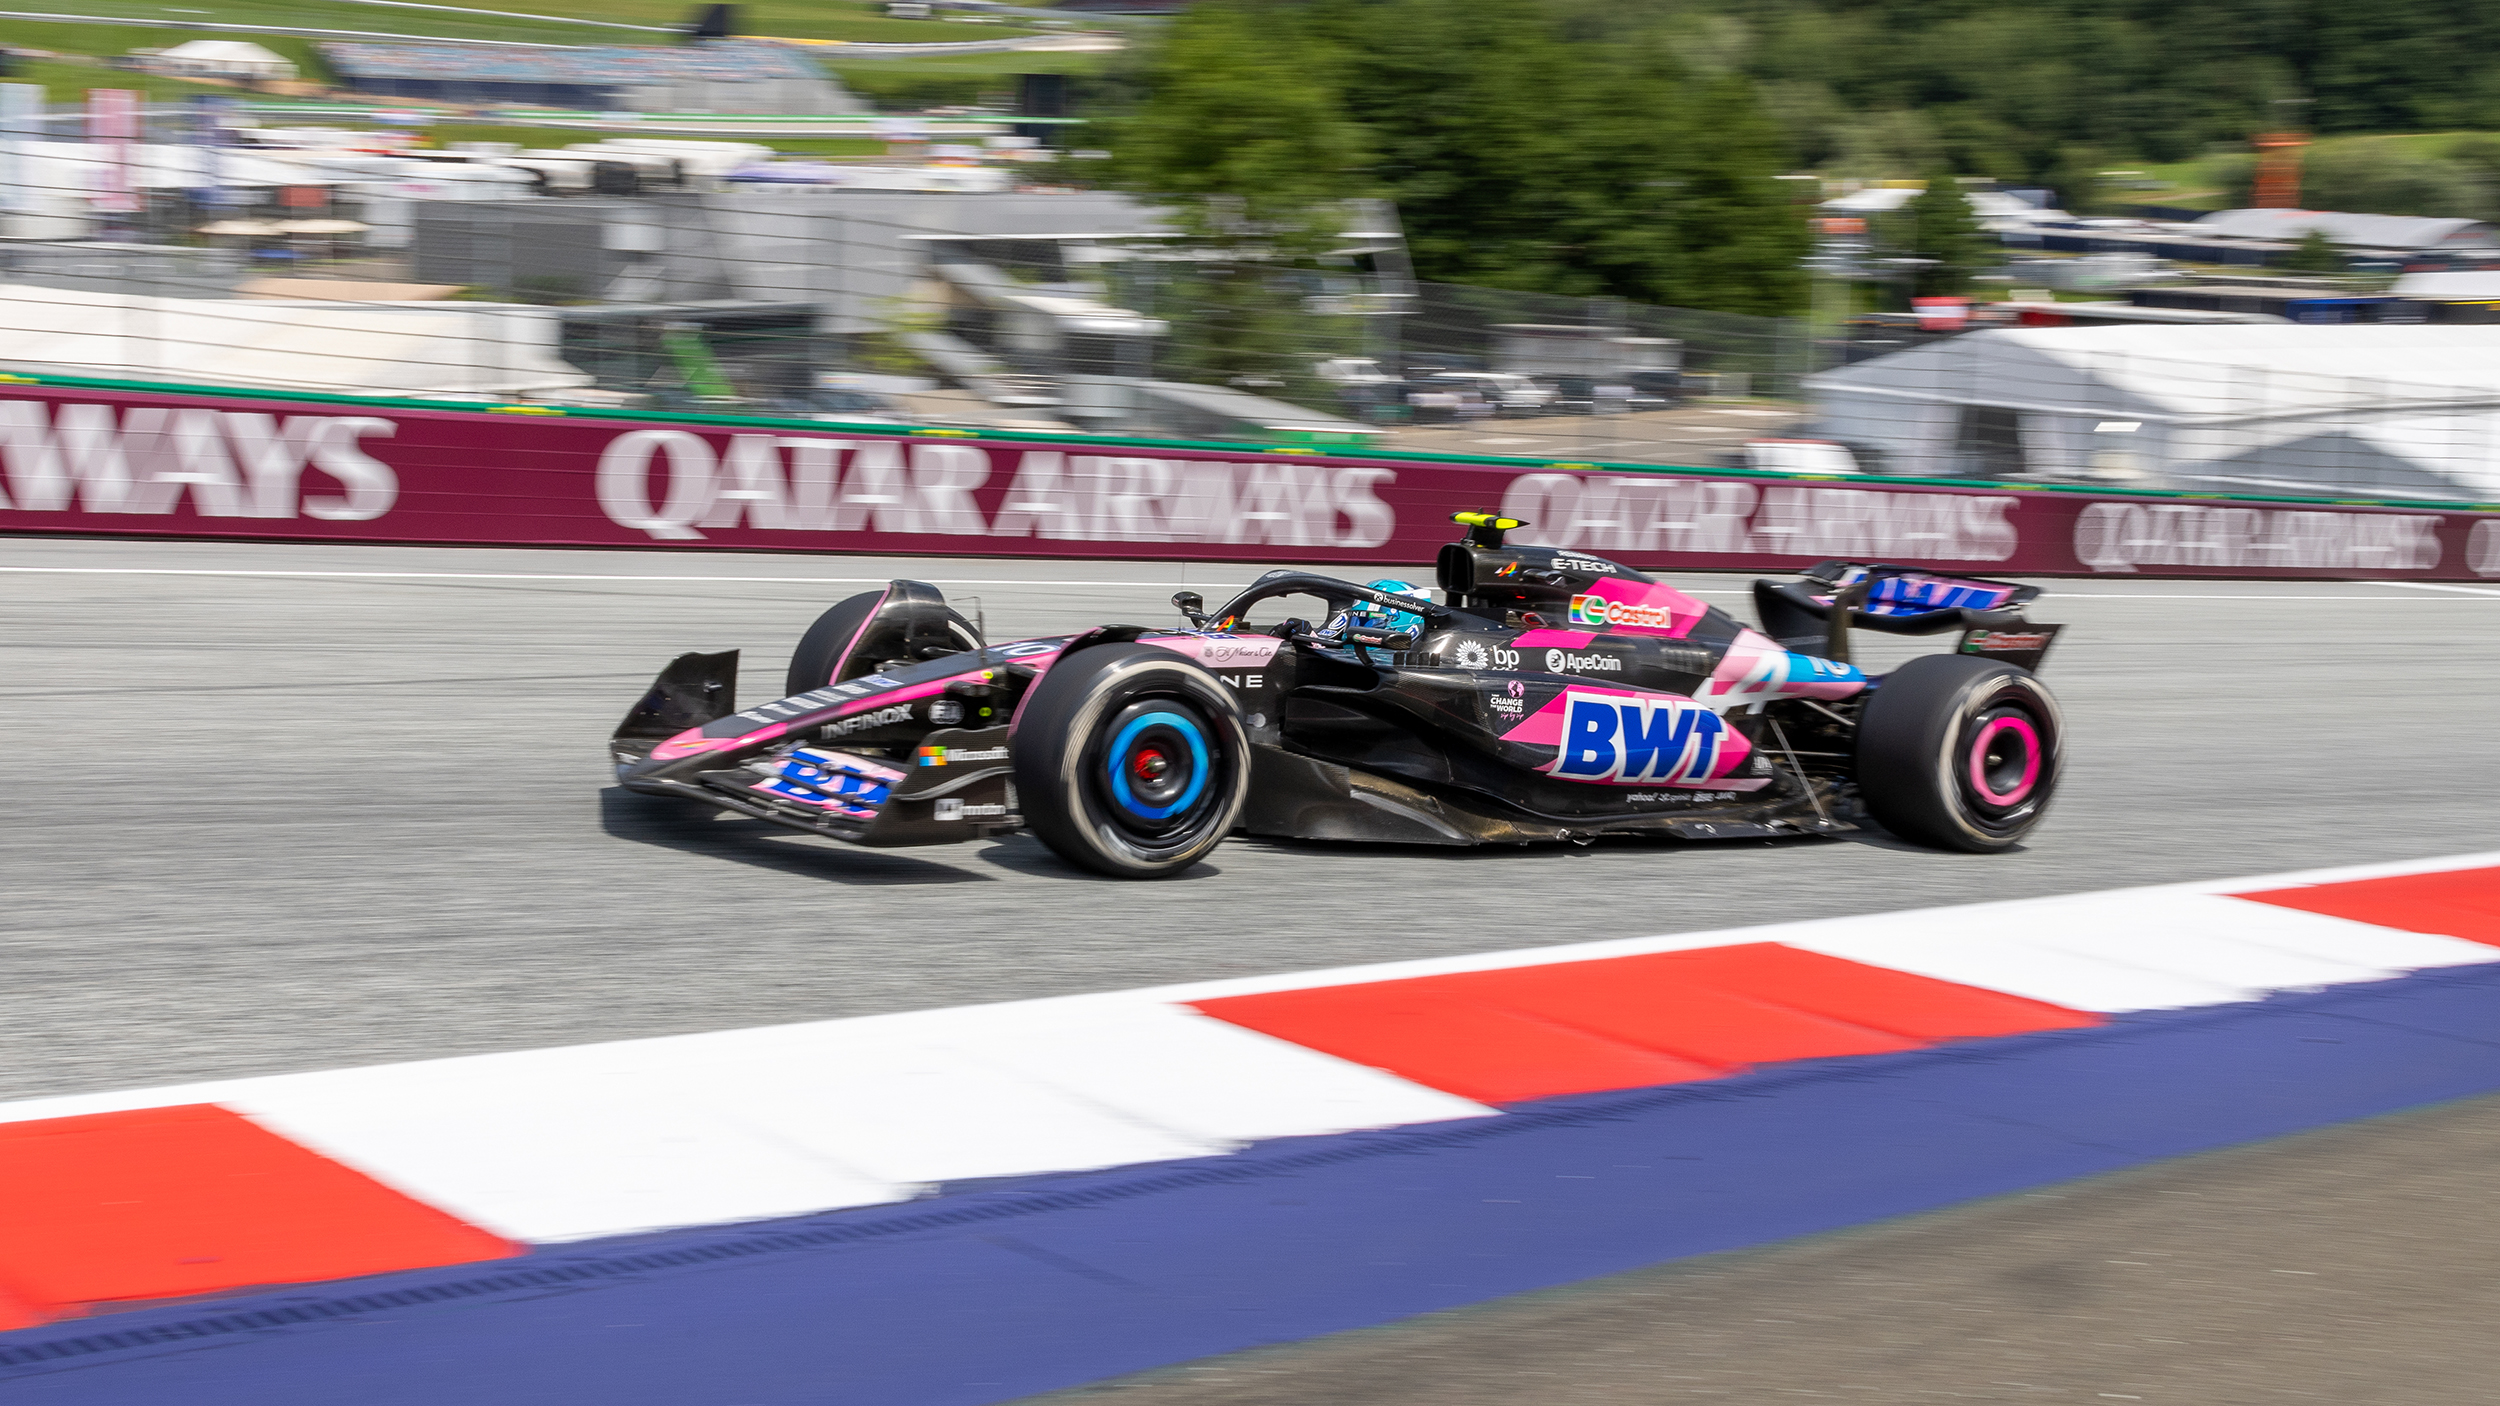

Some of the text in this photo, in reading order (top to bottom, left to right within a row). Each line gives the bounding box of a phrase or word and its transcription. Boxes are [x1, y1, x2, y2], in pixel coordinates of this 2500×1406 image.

[0, 400, 400, 521] WAYS
[595, 430, 1398, 548] QATAR AIRWAYS
[1500, 473, 1760, 554] QATAR
[1551, 558, 1617, 574] E-TECH
[1383, 595, 1425, 613] businessolver
[1605, 601, 1671, 628] Castrol
[1493, 645, 1520, 668] bp
[1566, 653, 1622, 673] ApeCoin
[1220, 674, 1263, 689] NE
[1490, 697, 1524, 707] CHANGE
[1496, 705, 1523, 713] WORLD
[1548, 691, 1728, 784] BWT
